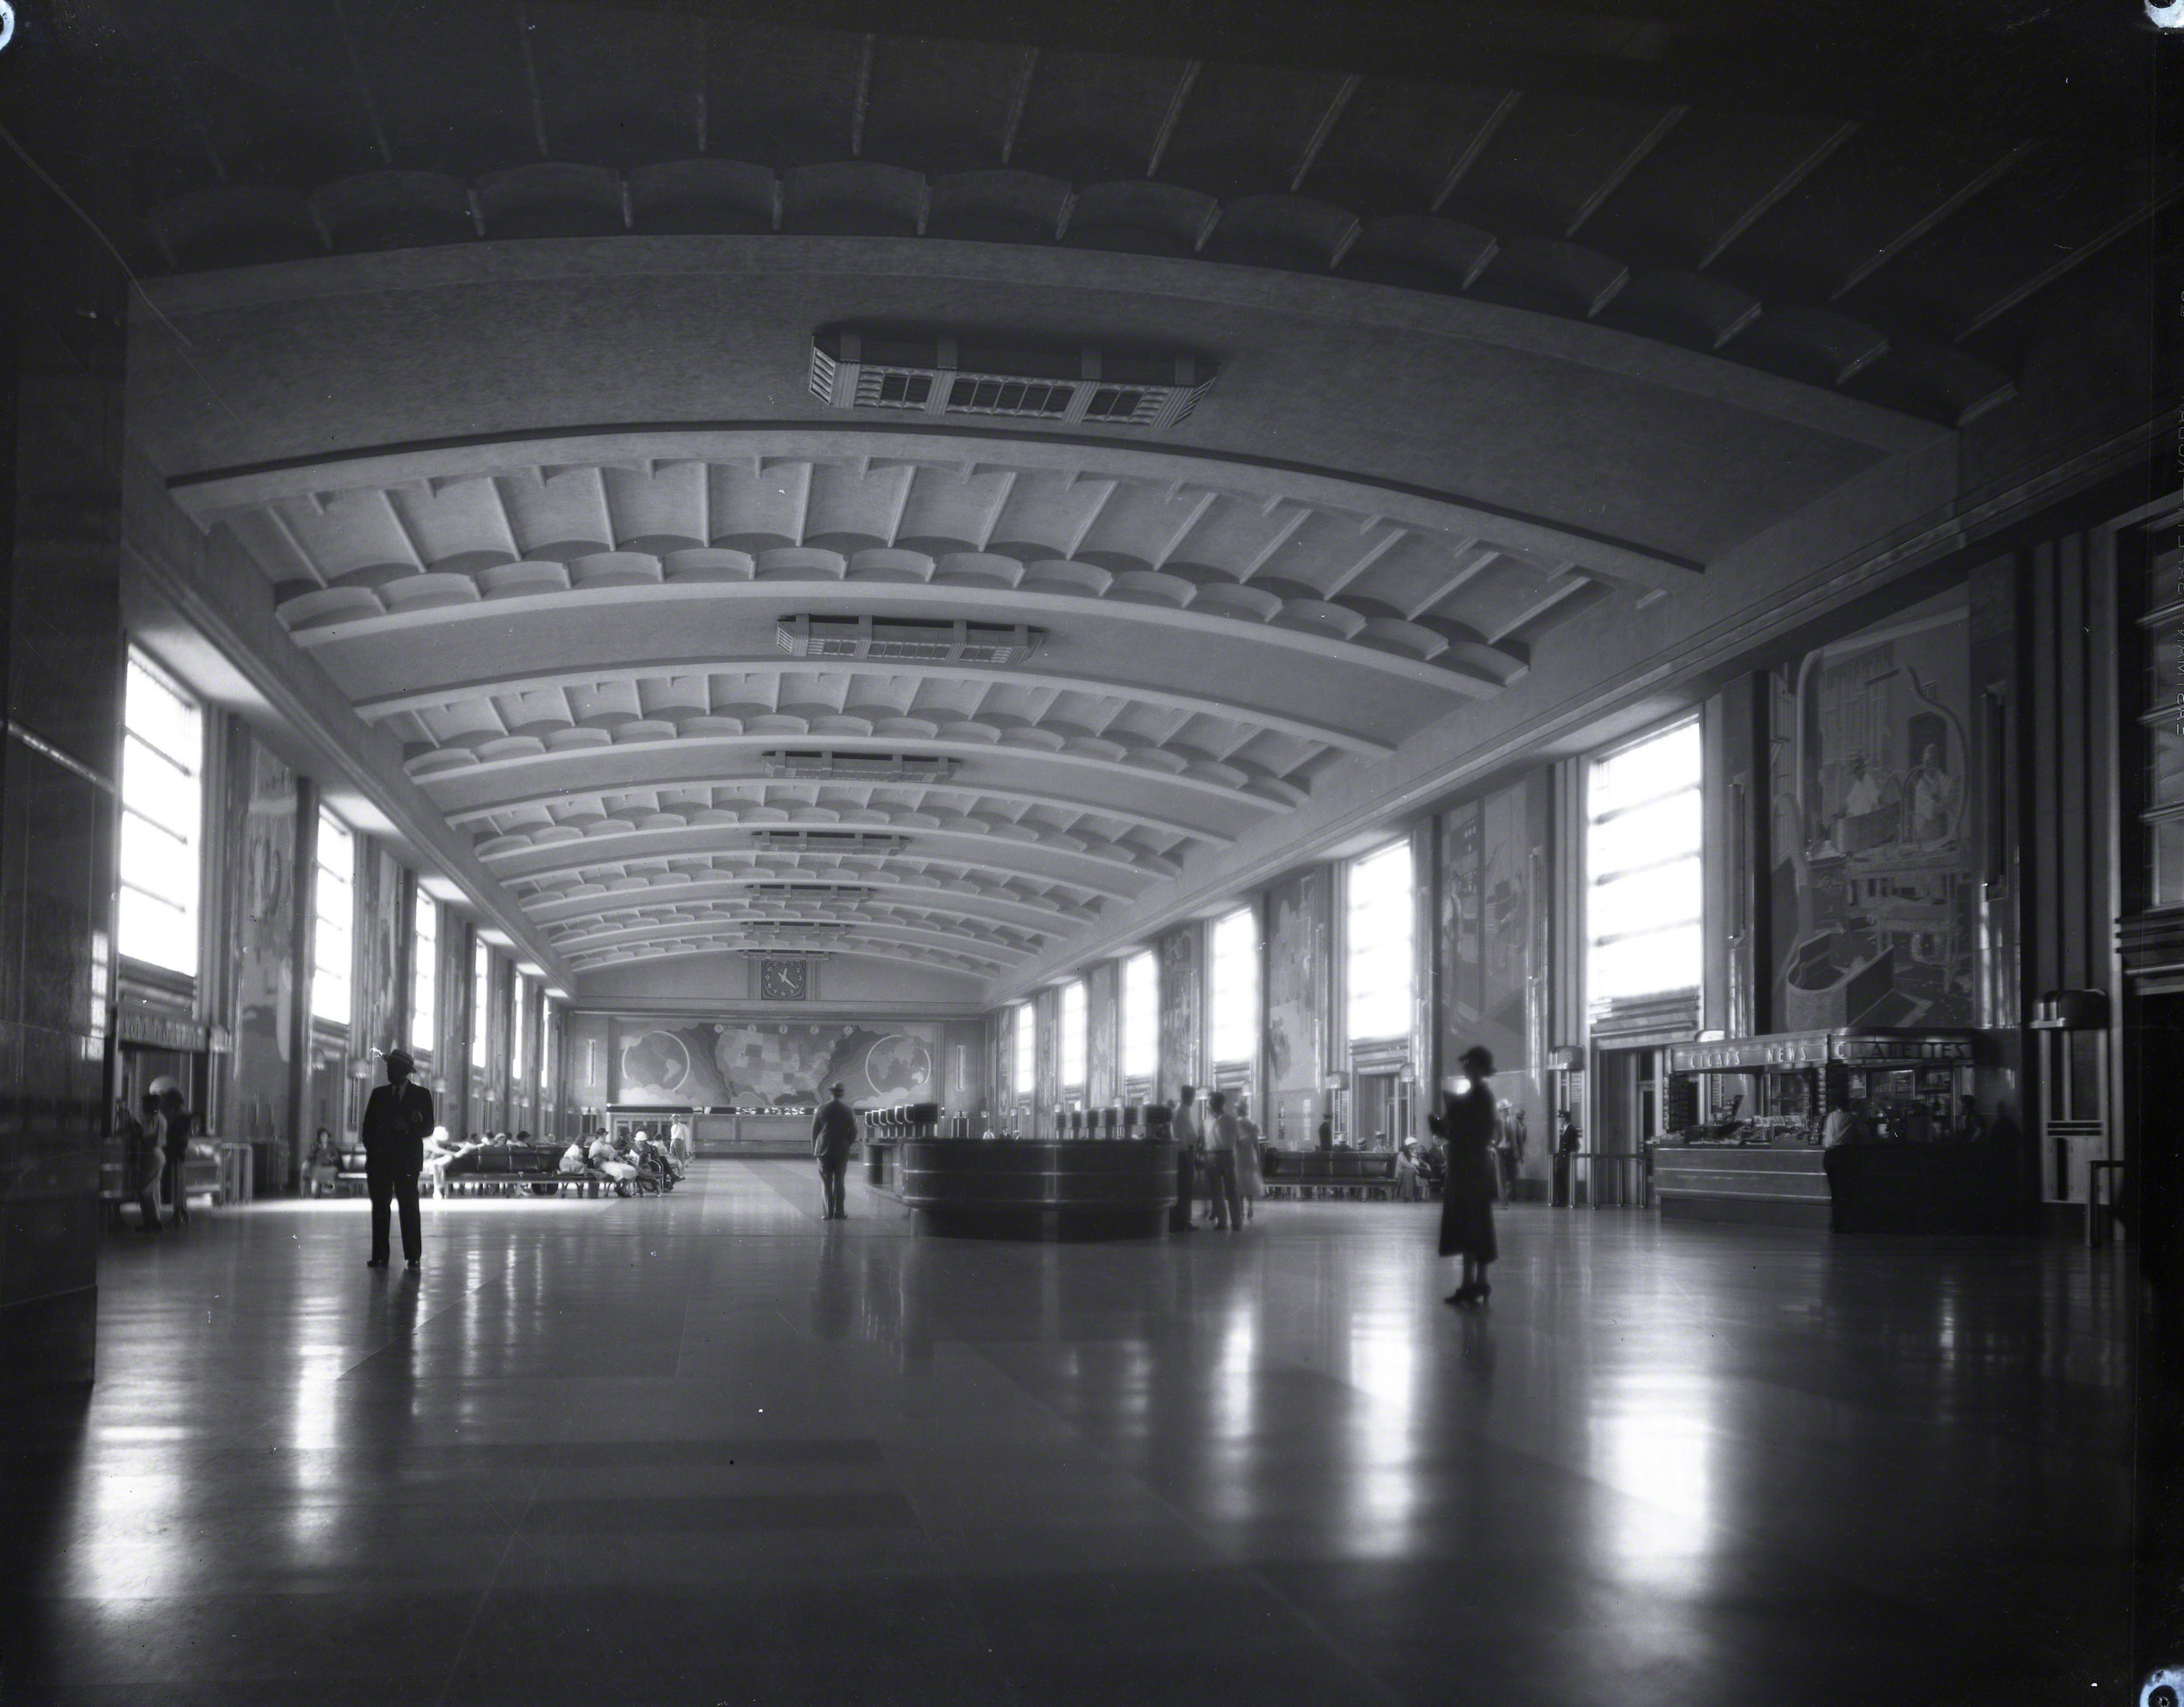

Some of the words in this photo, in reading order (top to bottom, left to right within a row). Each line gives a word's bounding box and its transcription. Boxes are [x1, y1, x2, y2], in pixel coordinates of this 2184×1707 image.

[1690, 1051, 1740, 1068] CIGARS
[1766, 1047, 1807, 1062] NEWS
[1836, 1041, 1966, 1059] CIARETTES
